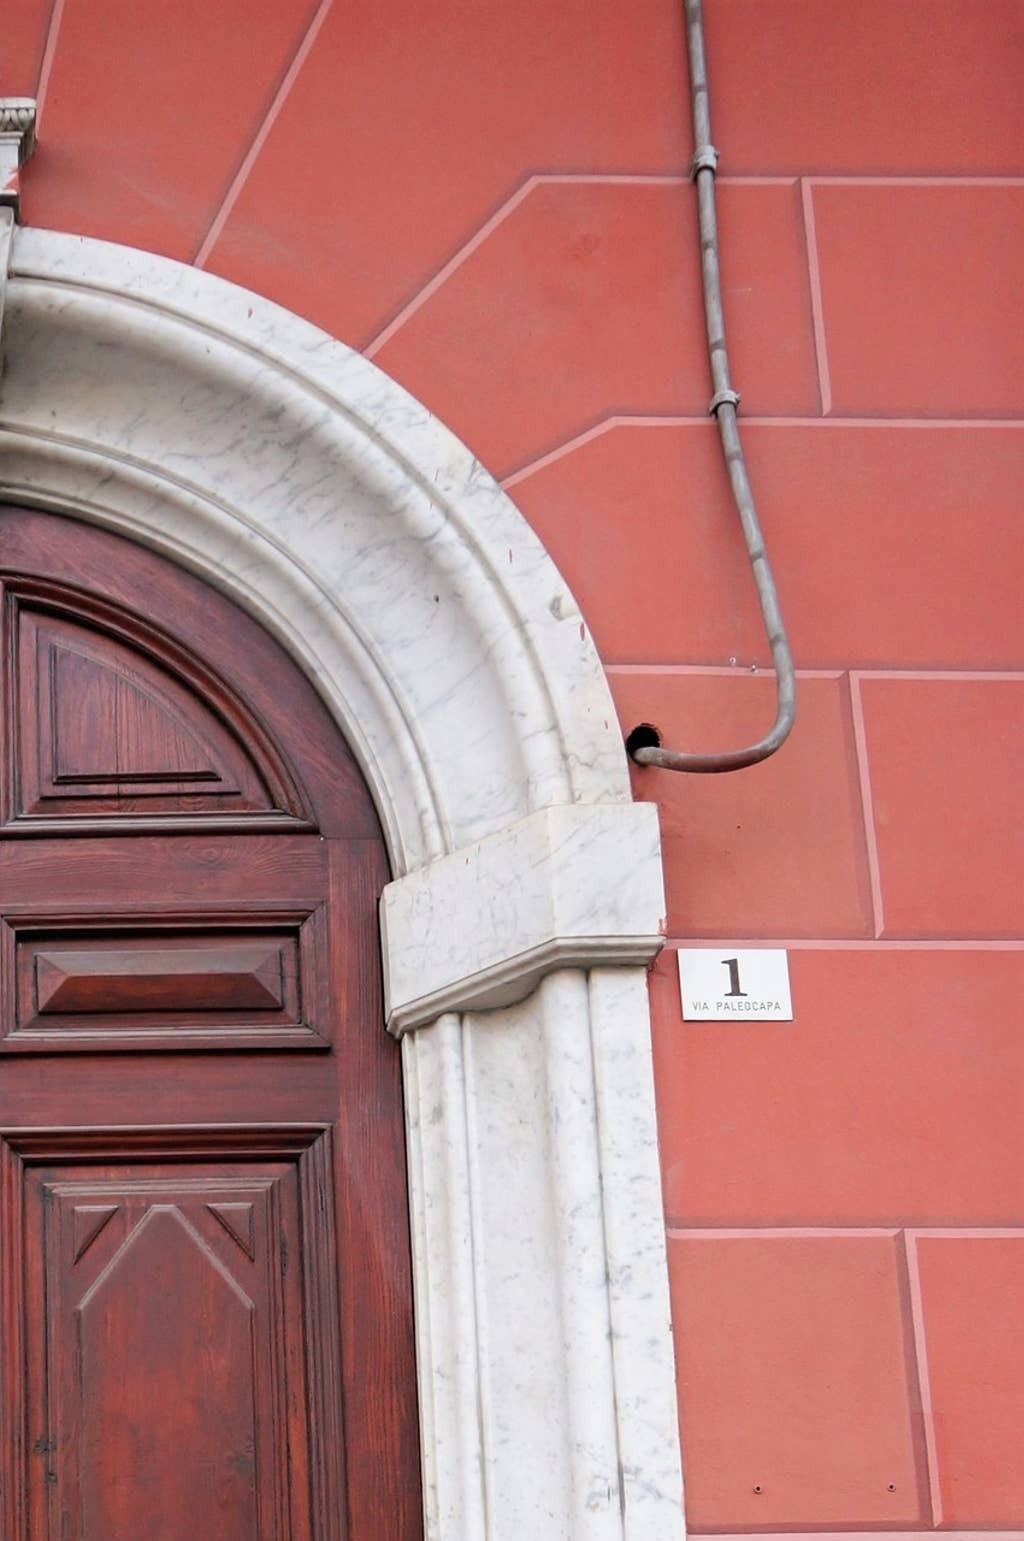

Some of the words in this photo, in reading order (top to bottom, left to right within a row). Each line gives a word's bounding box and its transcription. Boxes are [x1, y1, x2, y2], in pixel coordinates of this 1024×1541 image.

[721, 958, 748, 997] 1
[692, 1001, 709, 1011] VIA
[716, 1001, 782, 1012] PALEOCAPA
